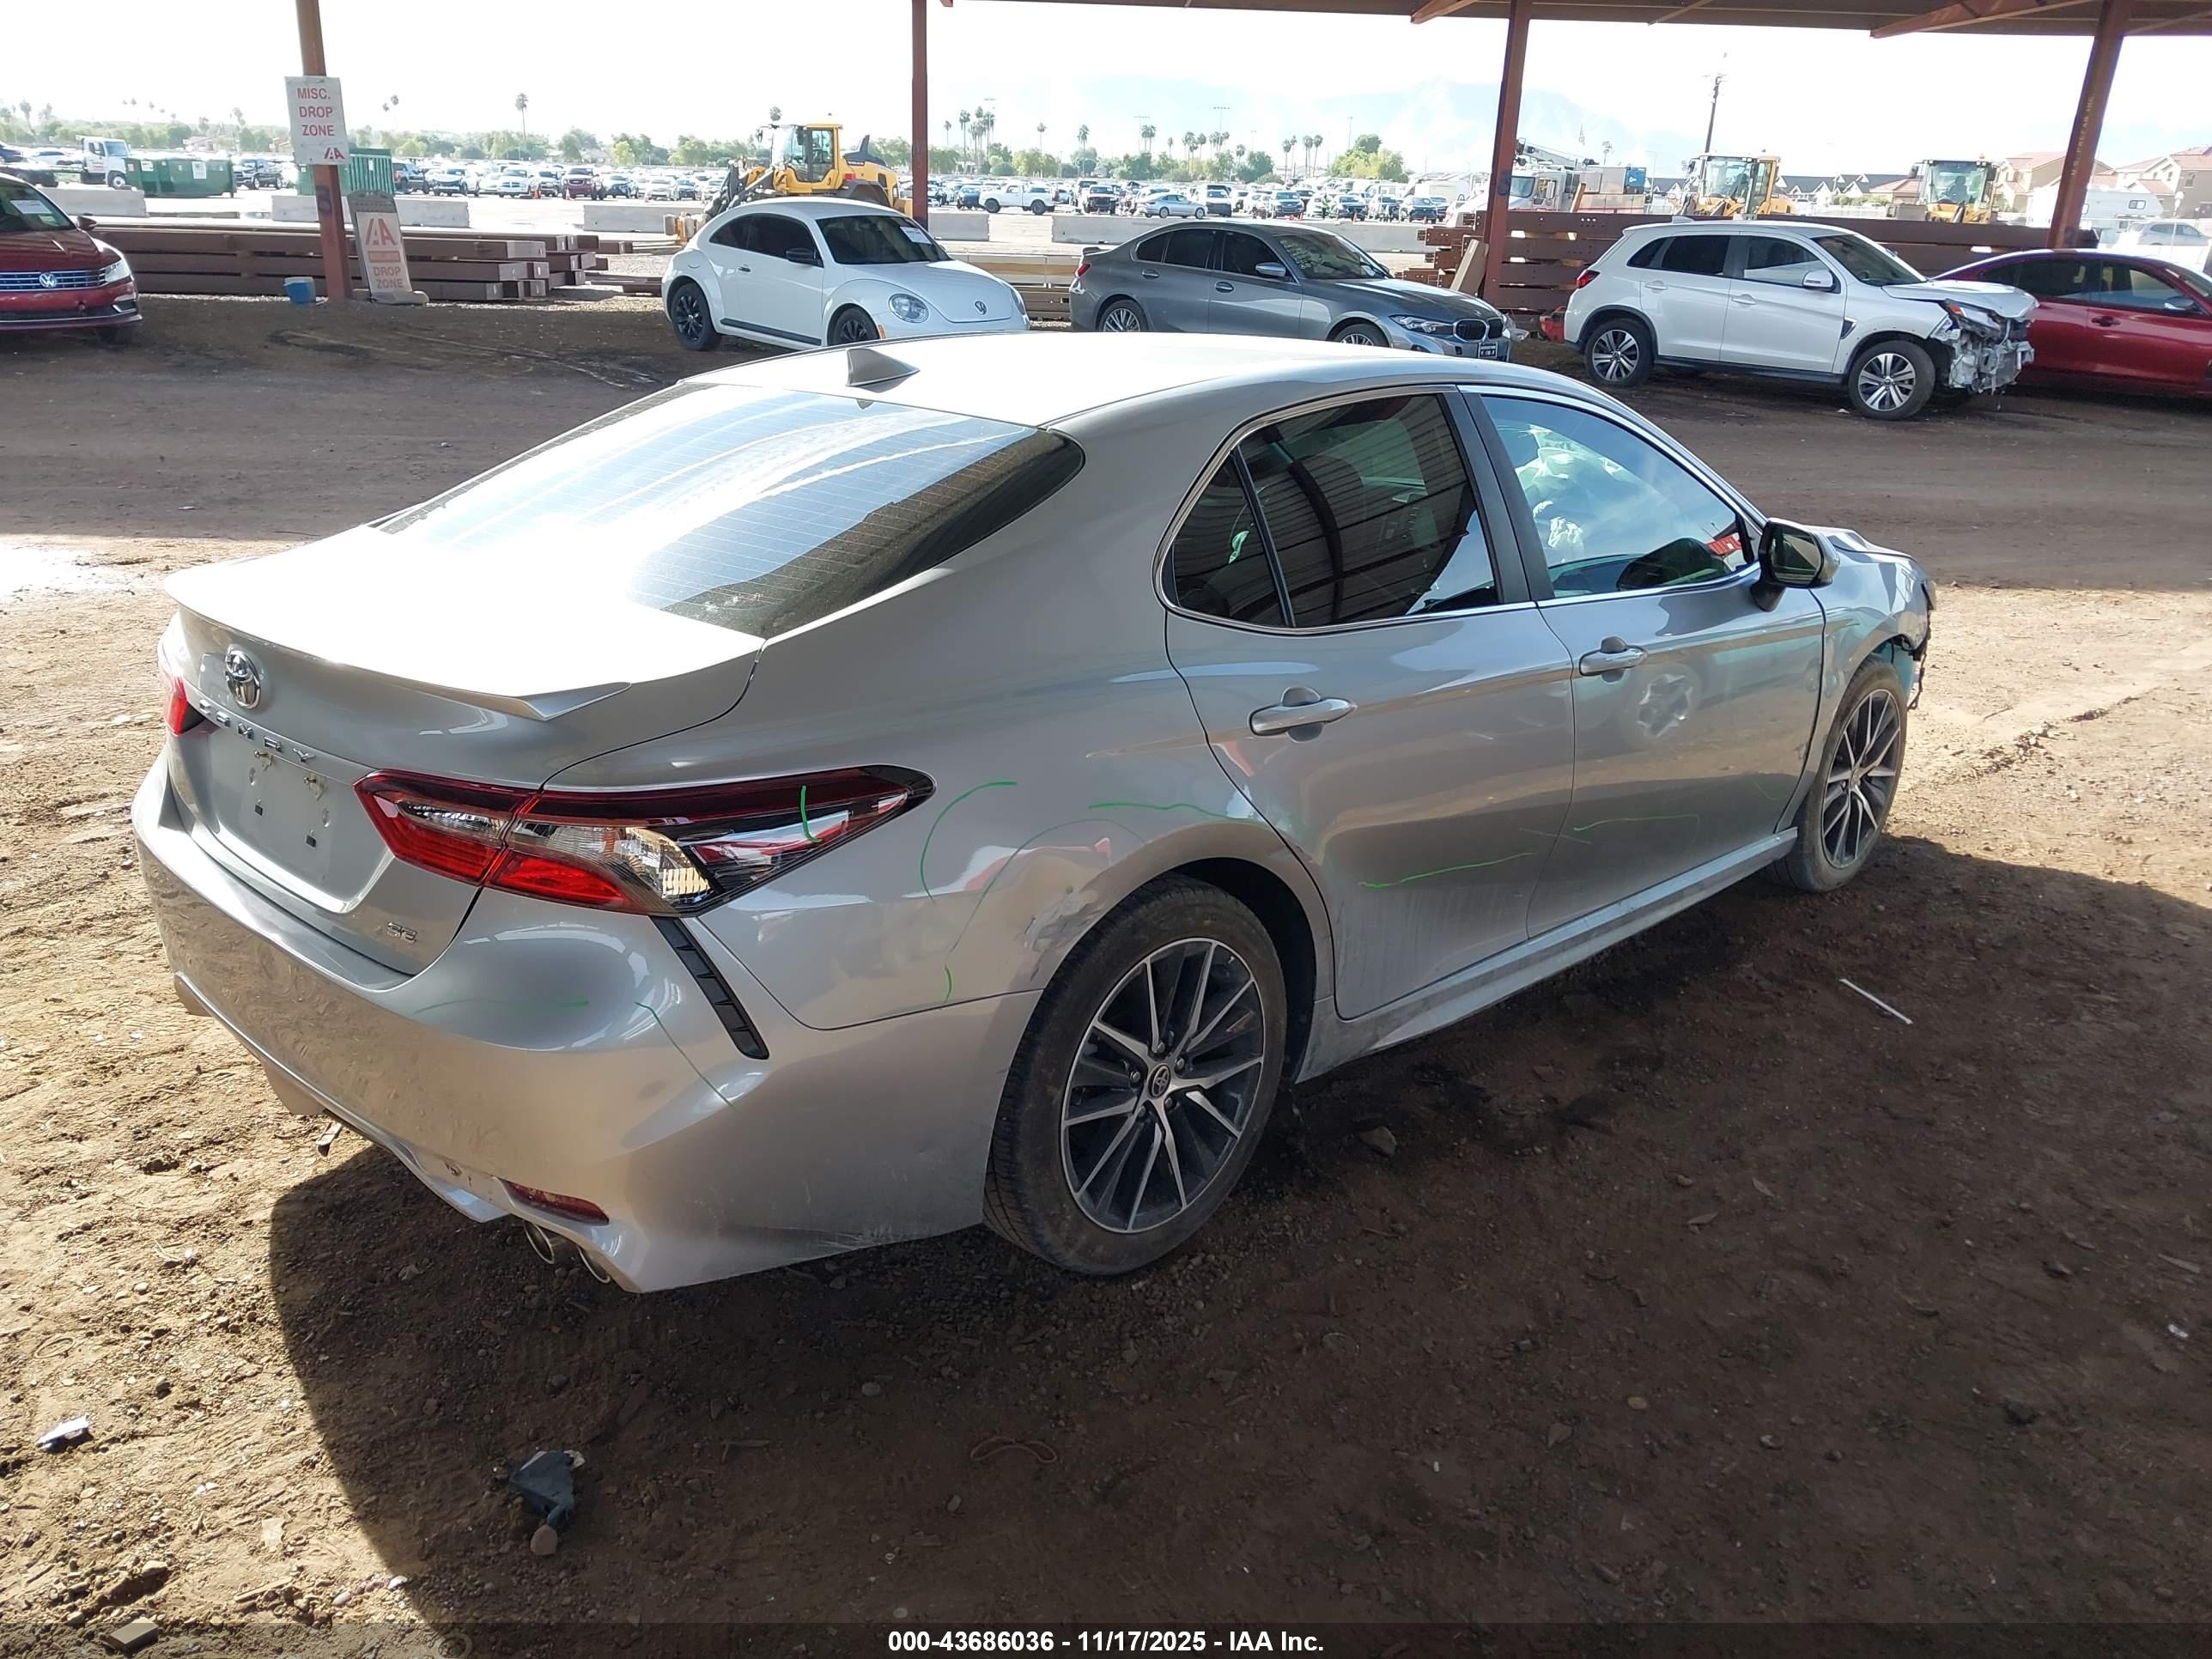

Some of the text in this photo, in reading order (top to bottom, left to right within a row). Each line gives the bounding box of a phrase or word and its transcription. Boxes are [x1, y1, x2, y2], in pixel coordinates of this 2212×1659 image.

[297, 88, 331, 100] MISC.
[299, 106, 333, 118] DROP
[302, 125, 335, 137] ZONE
[373, 266, 401, 276] DROP
[376, 278, 404, 289] ZONE
